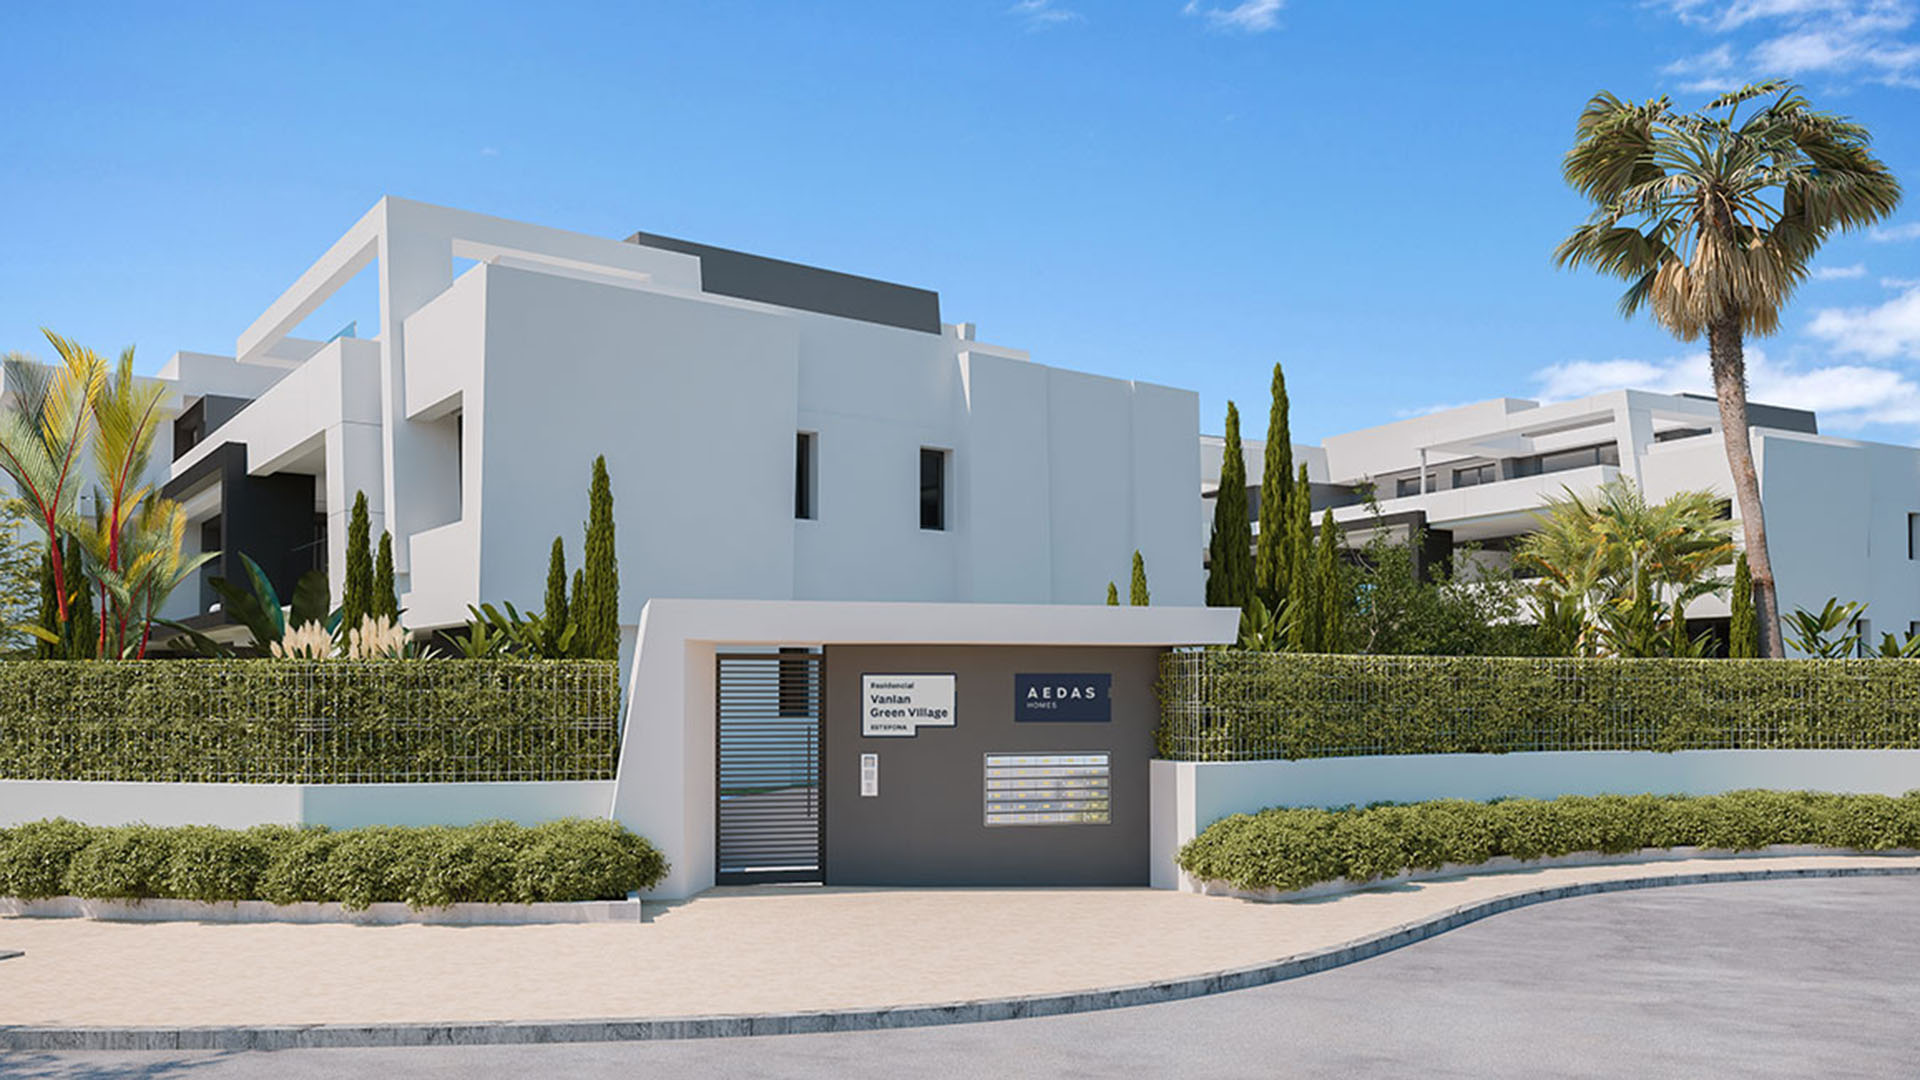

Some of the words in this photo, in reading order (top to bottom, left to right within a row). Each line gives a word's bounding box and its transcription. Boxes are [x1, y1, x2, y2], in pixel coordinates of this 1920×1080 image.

[1027, 686, 1096, 699] AEDAS
[1026, 701, 1058, 709] HOMES
[870, 707, 906, 718] Green
[908, 707, 948, 719] Village
